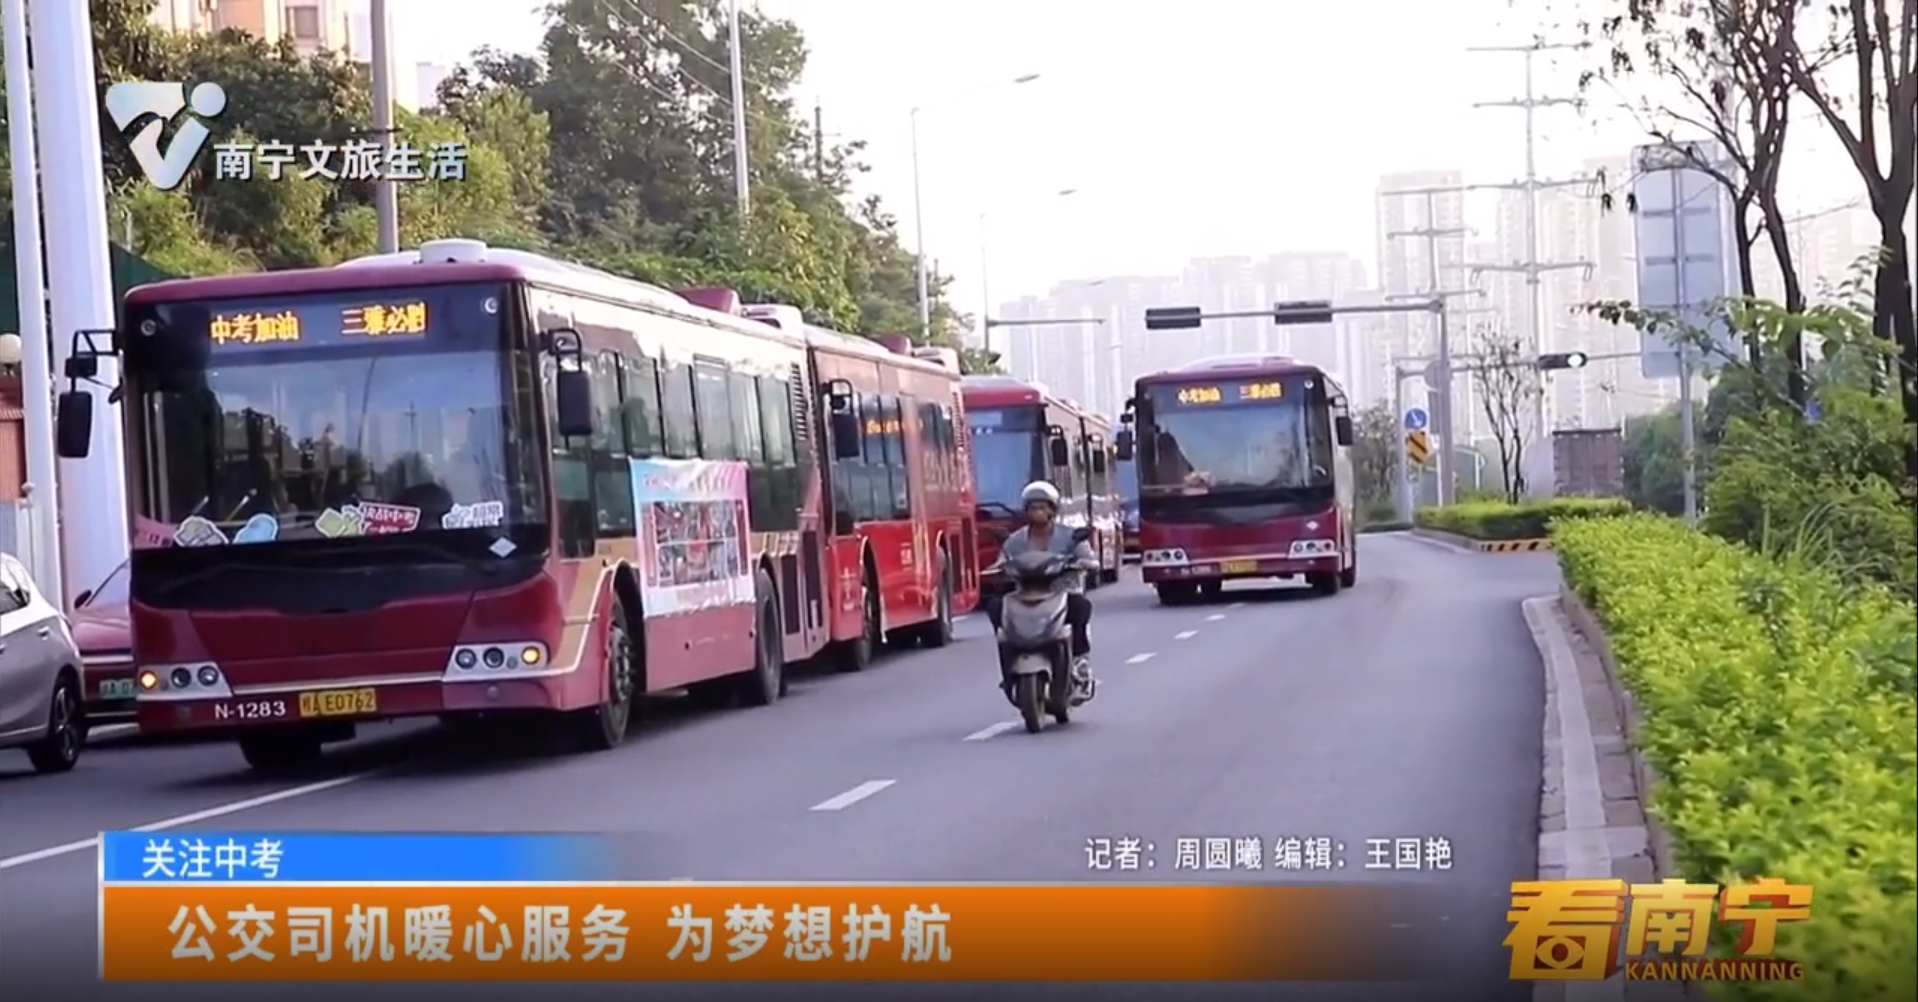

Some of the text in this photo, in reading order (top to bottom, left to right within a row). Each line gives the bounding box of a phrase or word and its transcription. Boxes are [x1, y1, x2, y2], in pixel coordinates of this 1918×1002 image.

[211, 310, 299, 344] 中考加油
[214, 700, 287, 719] N-1283
